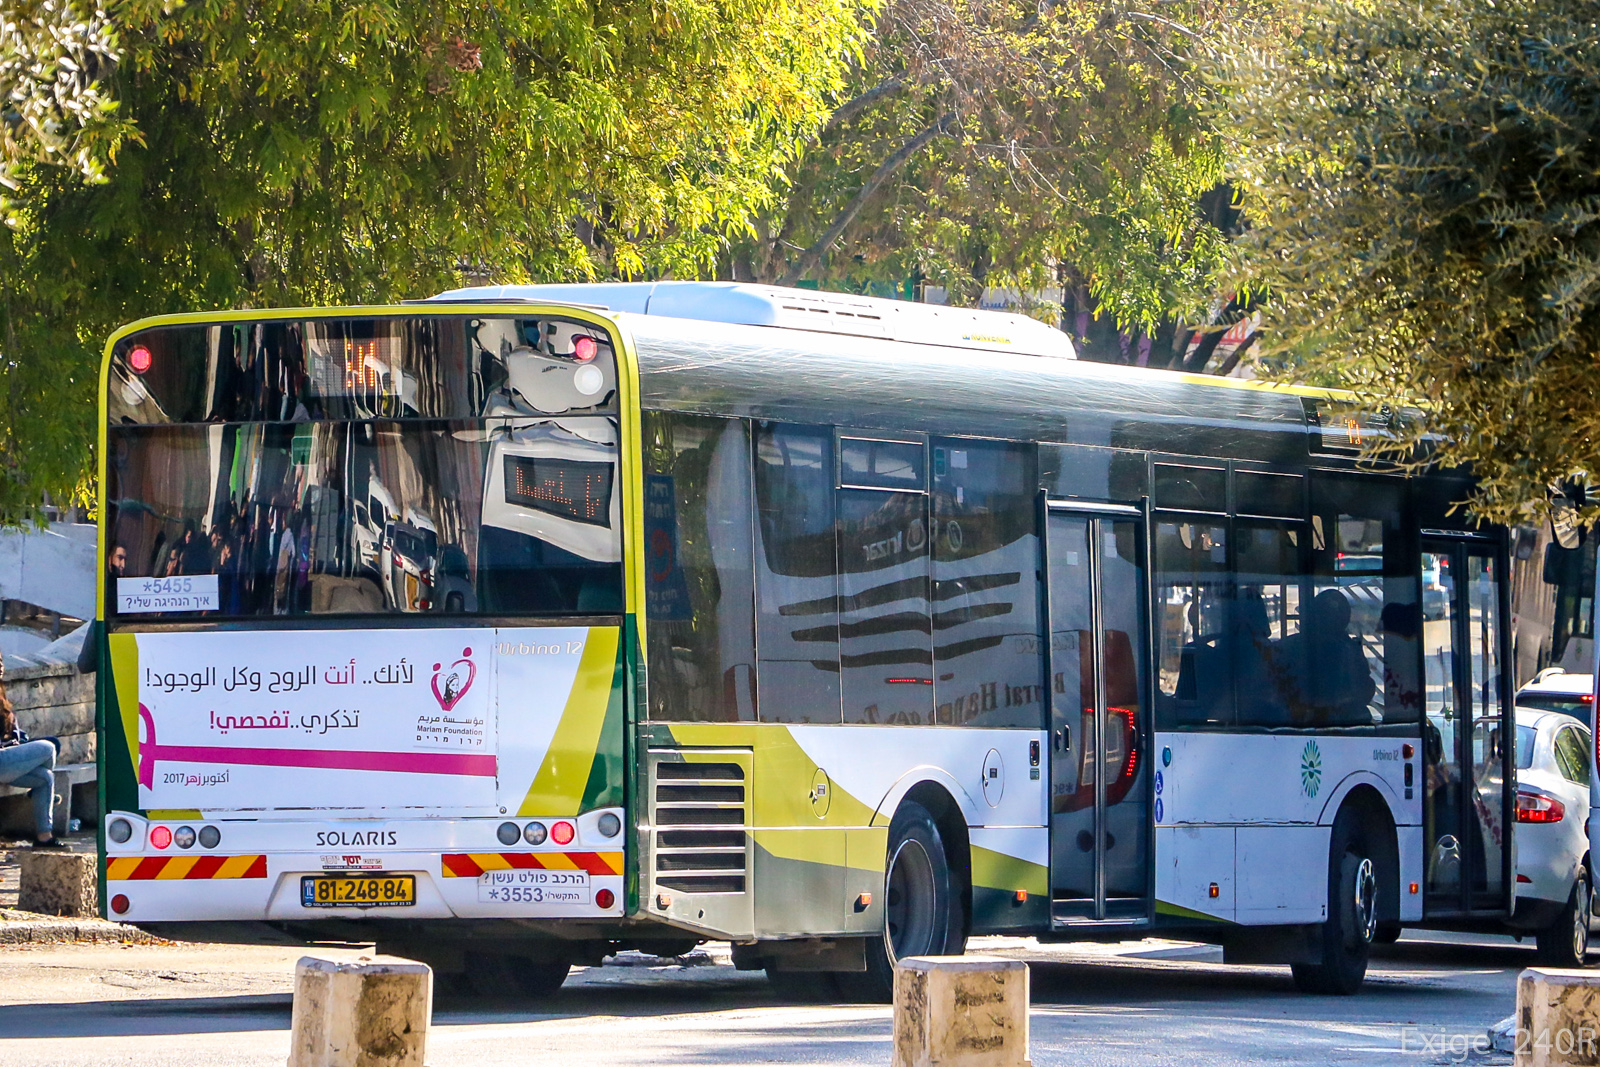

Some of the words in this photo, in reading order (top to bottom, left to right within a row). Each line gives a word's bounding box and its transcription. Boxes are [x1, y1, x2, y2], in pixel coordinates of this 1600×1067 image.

[126, 596, 151, 609] שלי?
[154, 597, 190, 608] הנהיגה
[193, 596, 210, 608] איך
[499, 641, 561, 656] Urbino
[565, 640, 583, 655] 12
[324, 658, 356, 685] أنت
[223, 666, 261, 692] وكل
[268, 665, 317, 693] الروح
[417, 715, 440, 724] مريم
[416, 725, 442, 733] Mariam
[443, 727, 483, 736] Foundation
[416, 735, 449, 743] מרים
[1372, 749, 1393, 761] Urbino
[316, 831, 397, 846] SOLARIS
[519, 871, 548, 883] פולט
[551, 874, 585, 884] הרכב
